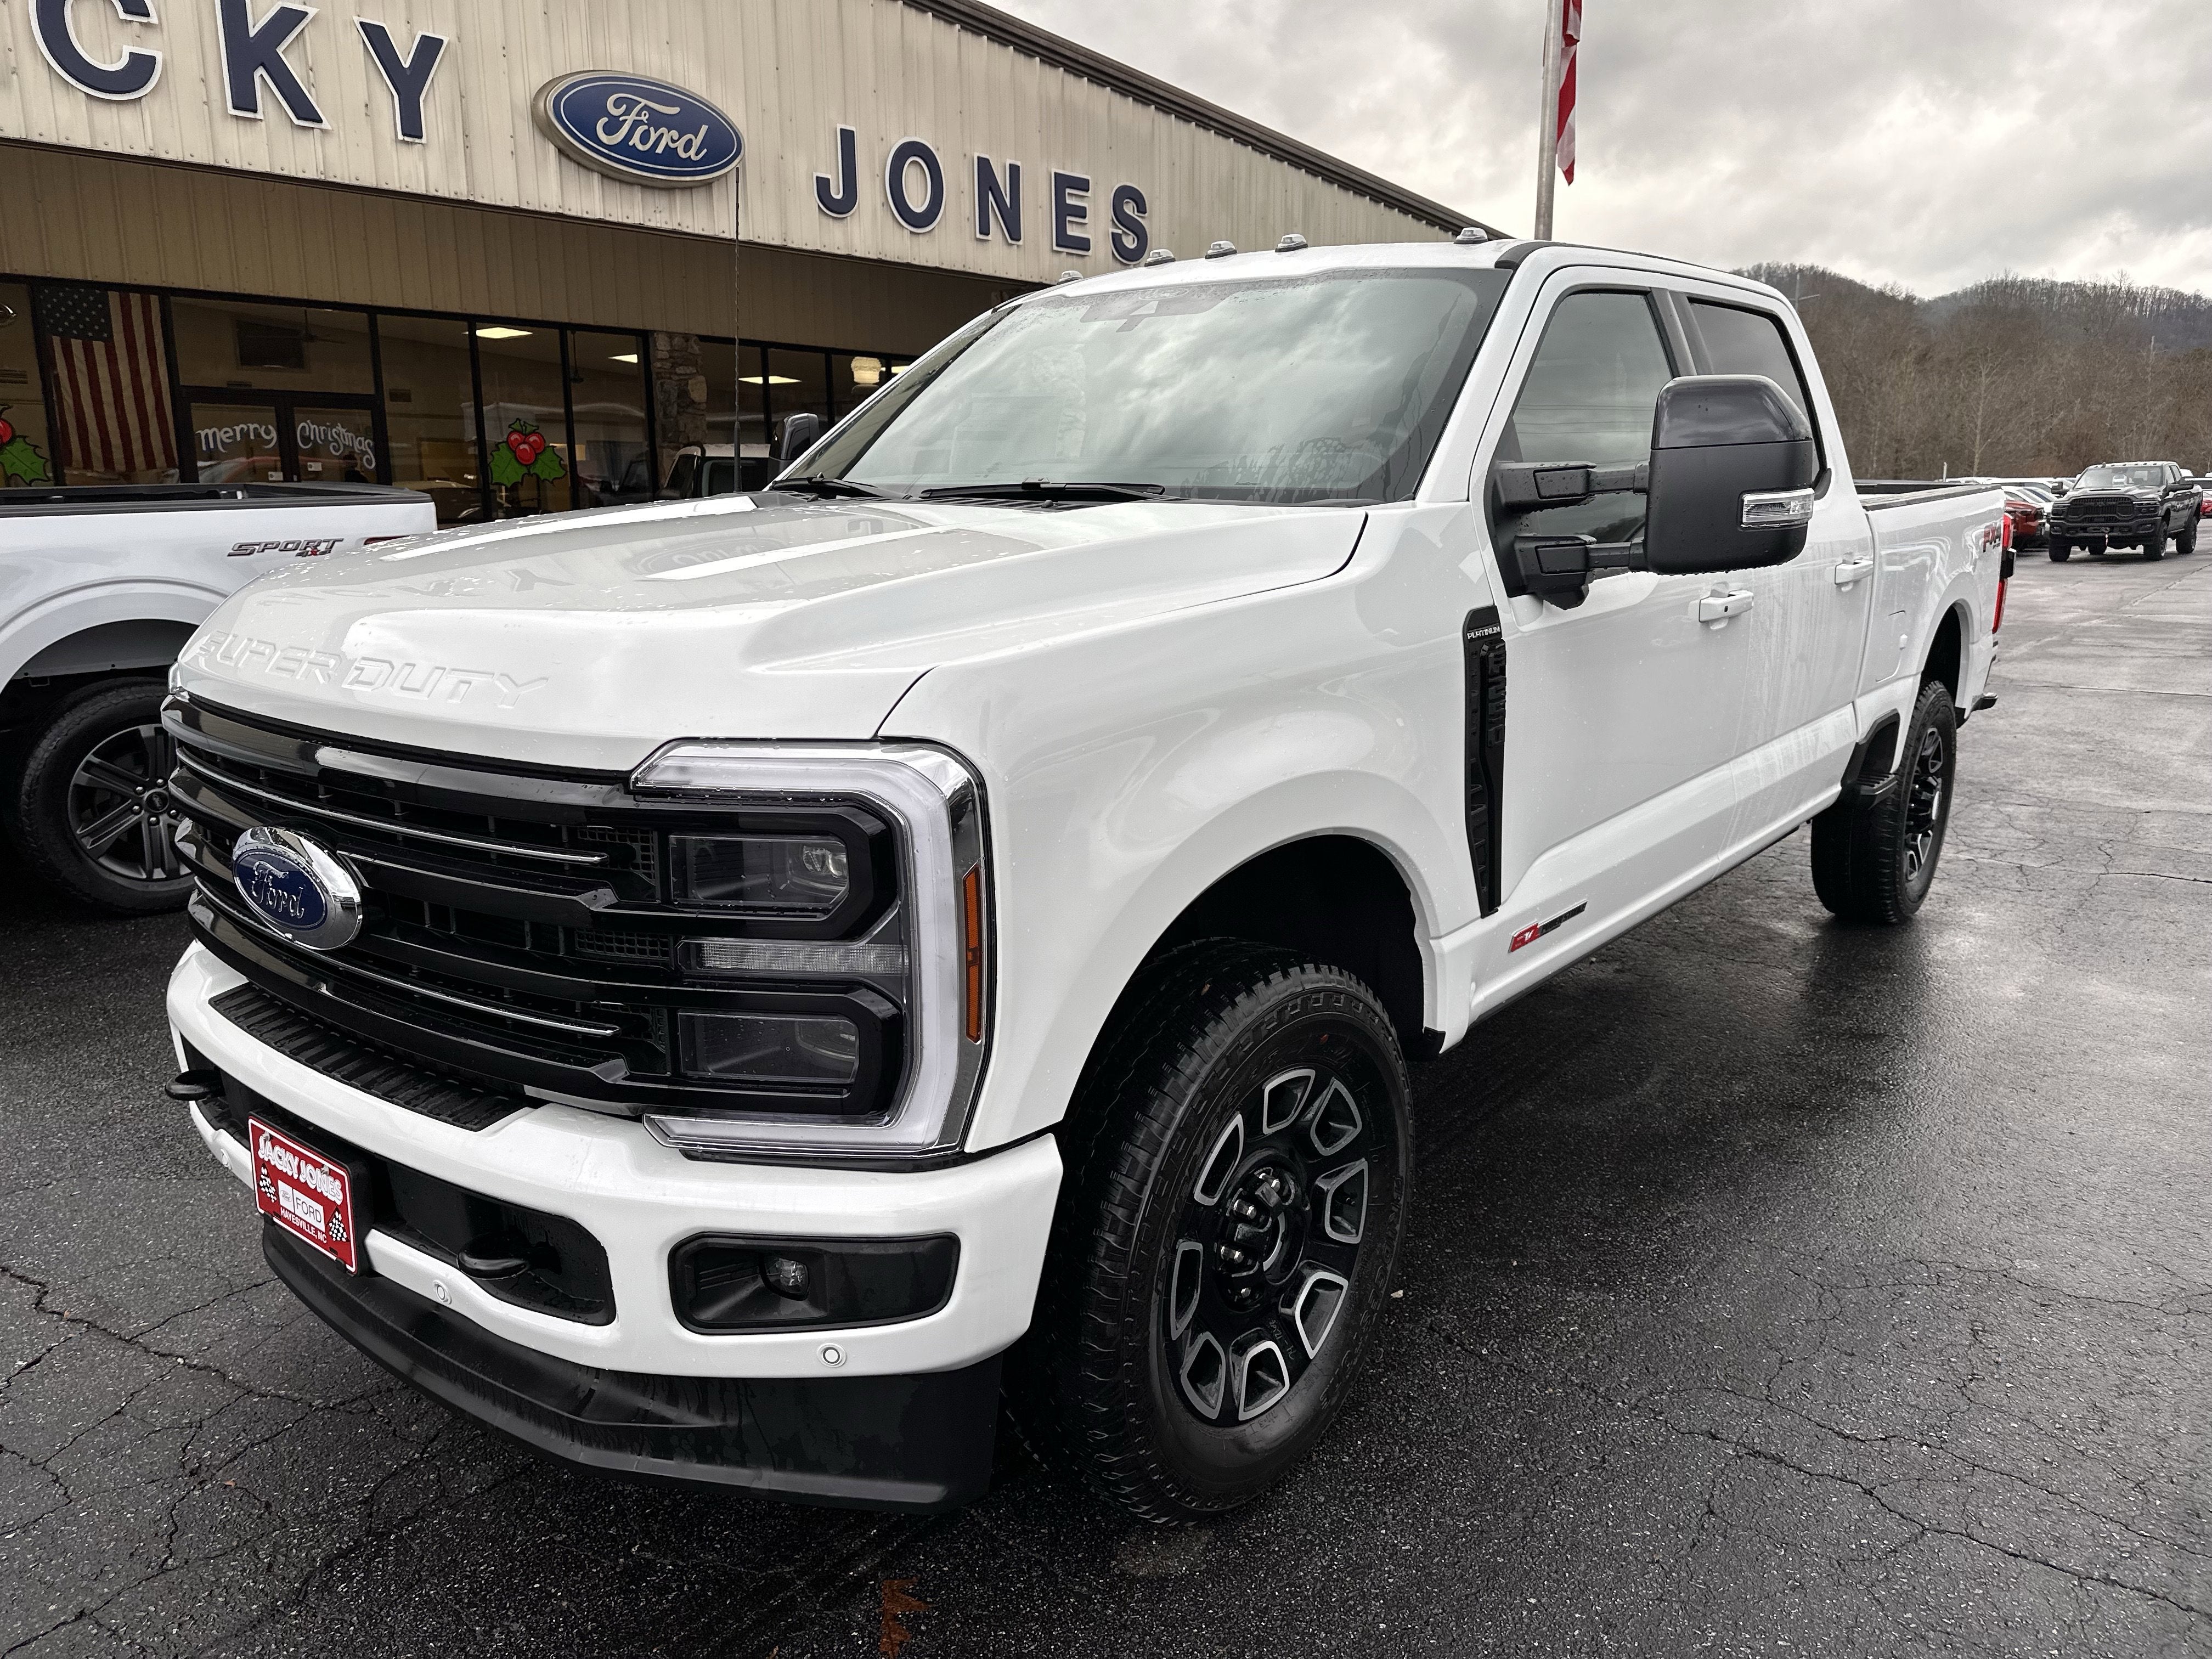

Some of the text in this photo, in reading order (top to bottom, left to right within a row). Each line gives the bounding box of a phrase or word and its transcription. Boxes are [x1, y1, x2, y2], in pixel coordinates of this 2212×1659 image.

[595, 92, 709, 161] Ford
[813, 124, 1149, 266] JONES
[227, 538, 344, 557] SPORT
[1466, 626, 1501, 640] PLATINUM
[198, 630, 549, 709] SUPER DUTY
[251, 860, 305, 919] Ford
[258, 1135, 343, 1205] JACKY JONES
[296, 1197, 322, 1223] FORD
[318, 1230, 328, 1244] NC
